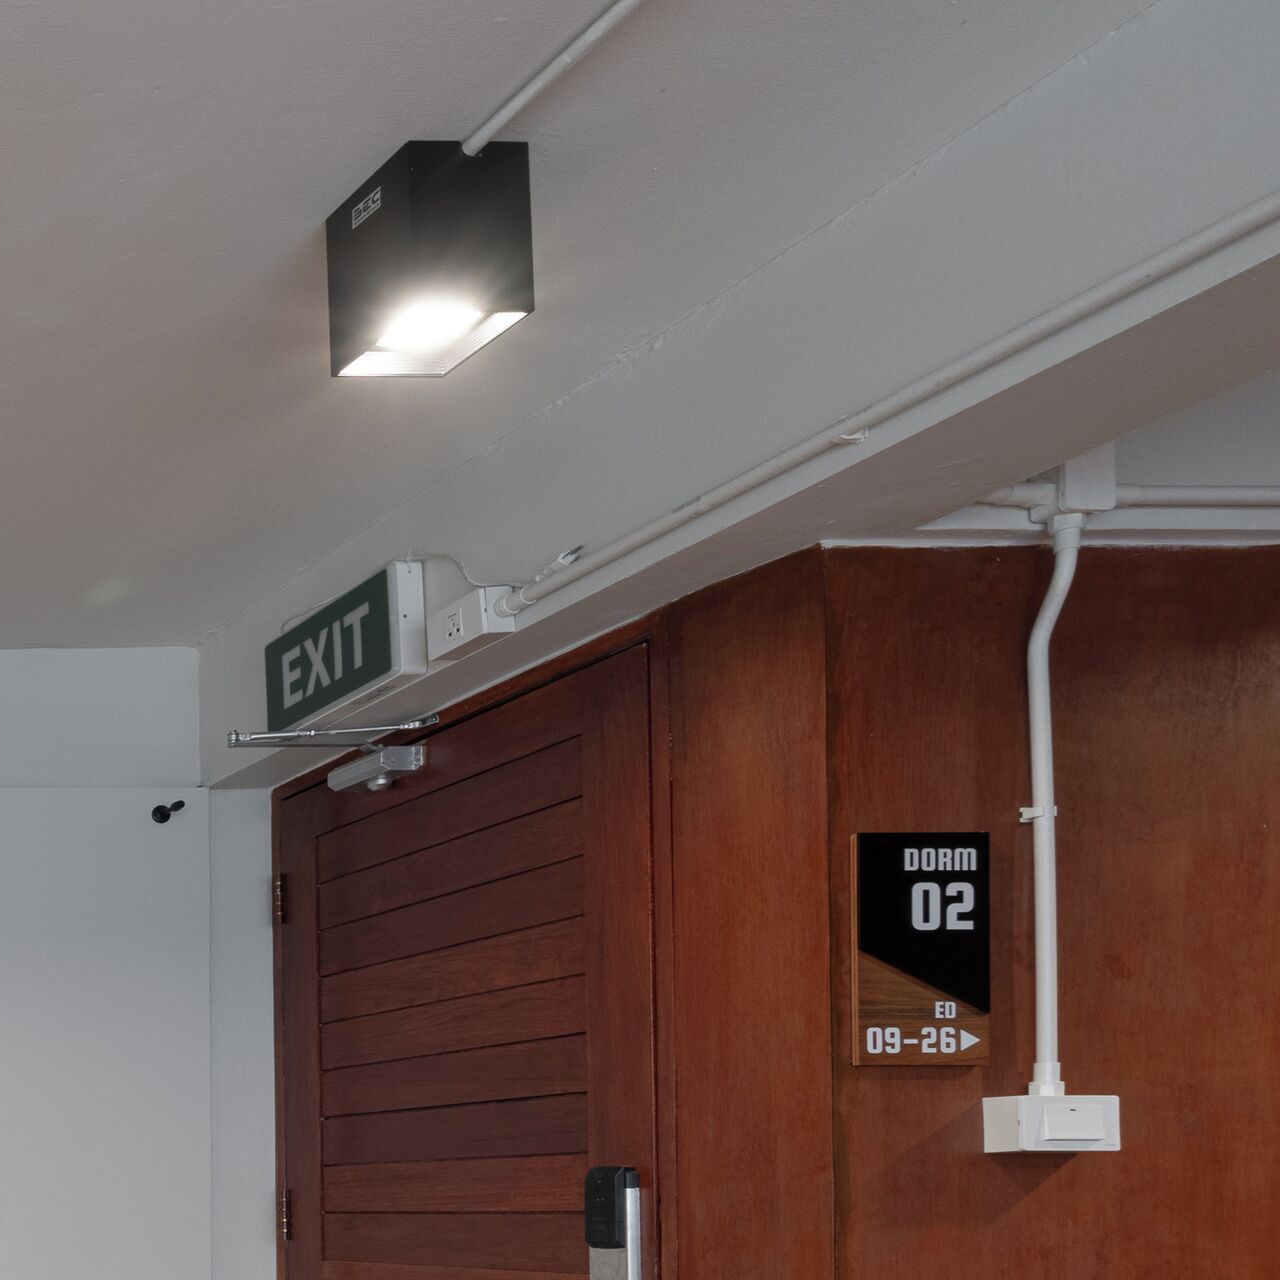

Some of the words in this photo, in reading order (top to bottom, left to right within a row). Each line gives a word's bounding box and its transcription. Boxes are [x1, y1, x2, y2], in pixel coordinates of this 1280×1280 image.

[281, 601, 370, 710] EXIT
[904, 847, 977, 872] DORM
[911, 881, 975, 931] 02
[934, 1001, 957, 1019] ED
[866, 1026, 957, 1054] 09-26
